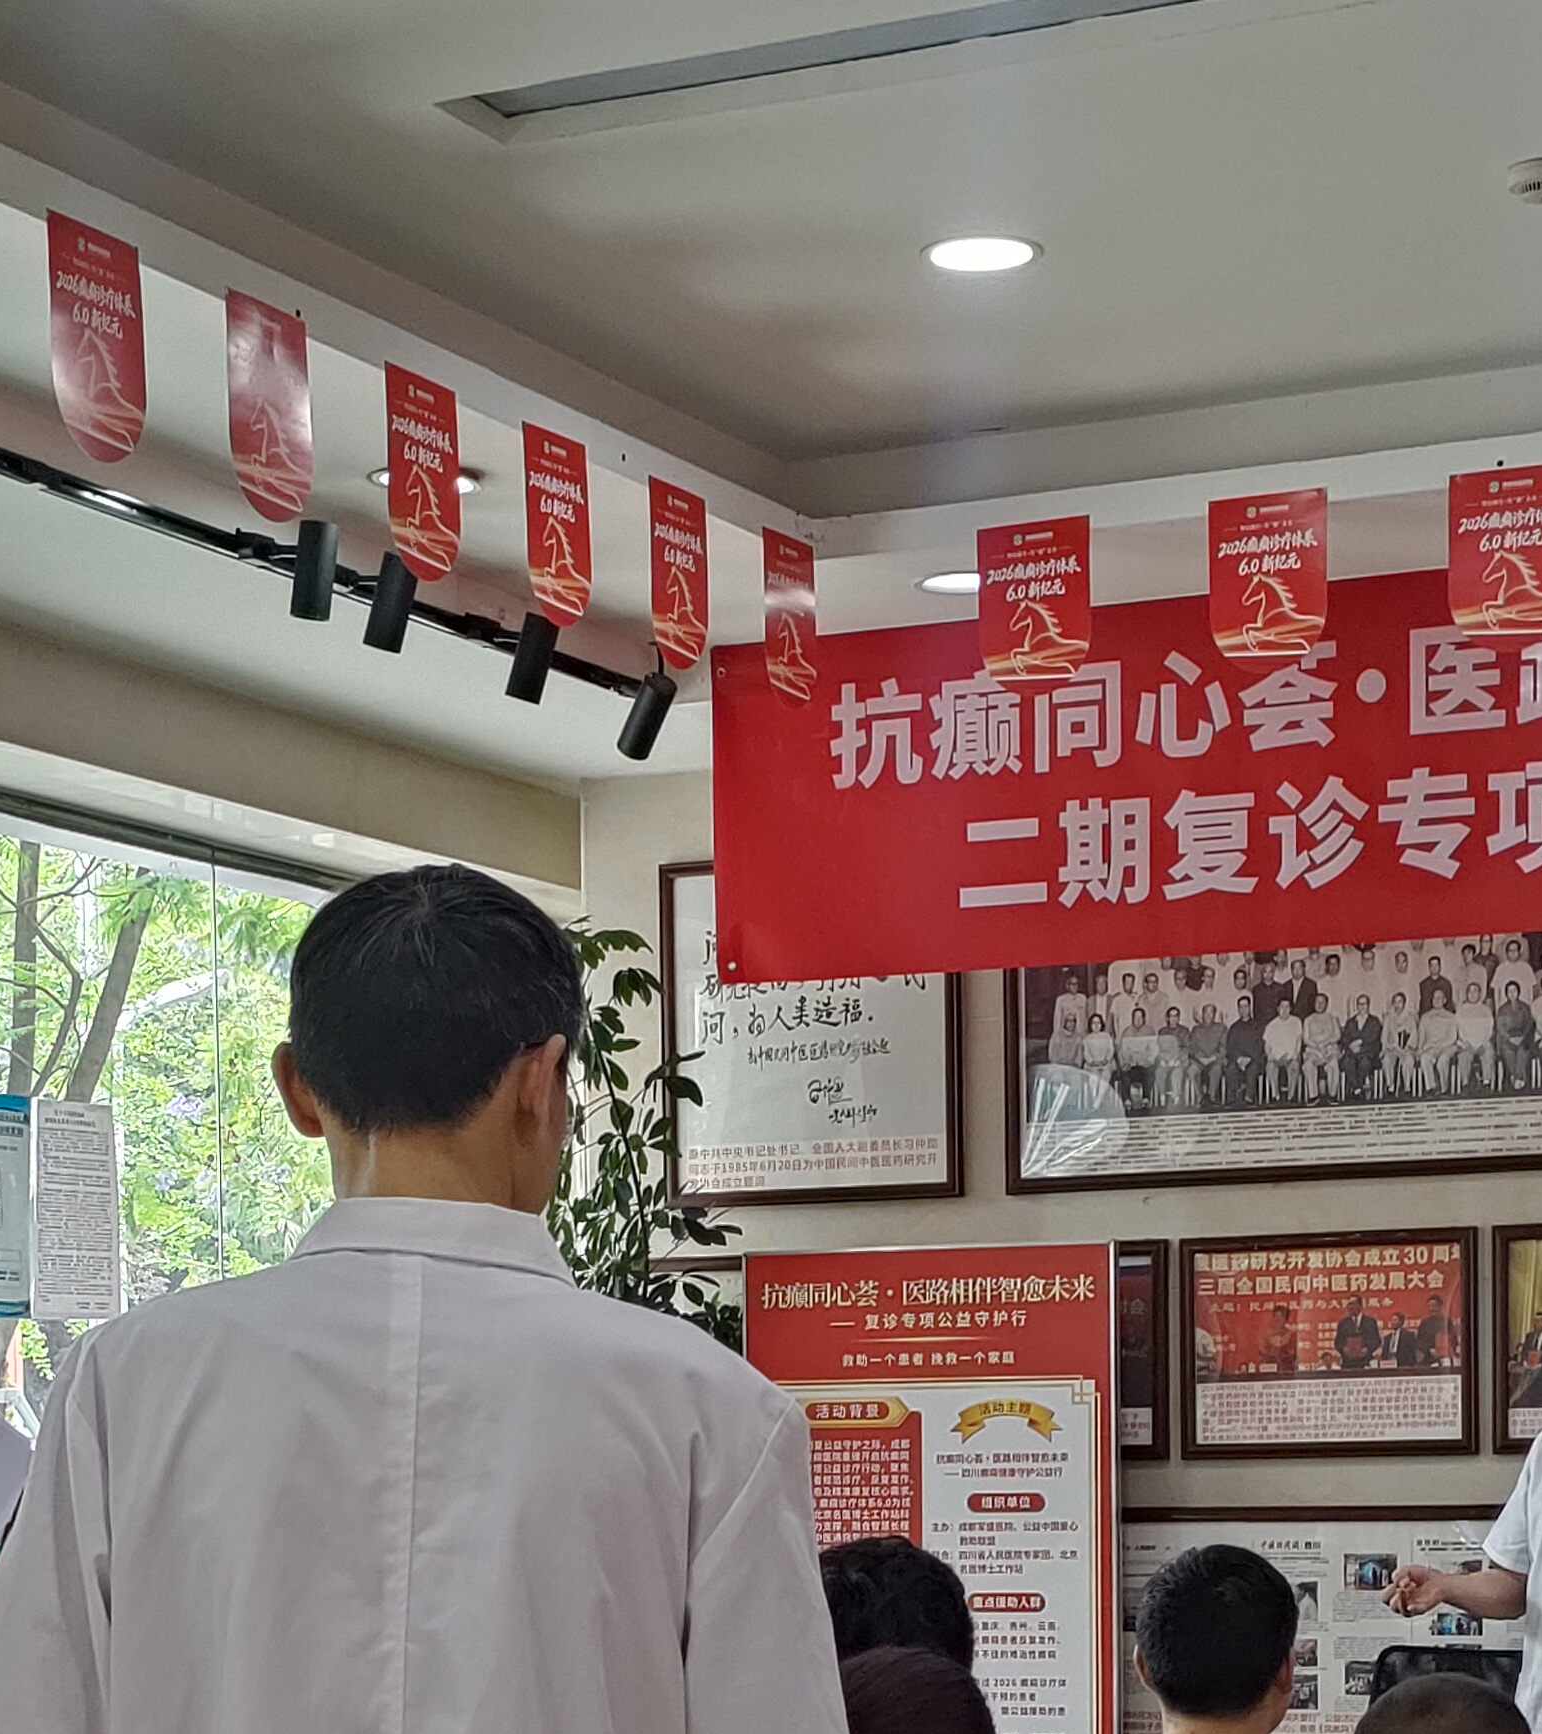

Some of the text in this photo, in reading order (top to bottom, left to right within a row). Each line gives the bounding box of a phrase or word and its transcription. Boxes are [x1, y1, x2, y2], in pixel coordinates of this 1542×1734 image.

[1479, 532, 1502, 553] 6.0
[1237, 555, 1261, 576] 6.0
[1006, 581, 1027, 601] 6.0
[761, 1273, 1096, 1310] 抗癫同心荟·医路相伴智愈未来
[864, 1310, 1028, 1331] 复诊专项公益守护行
[842, 1352, 924, 1367] 救助一个患者
[815, 1403, 880, 1419] 活动背景
[980, 1400, 1032, 1416] 活动主题
[981, 1496, 1032, 1509] 组织单位
[976, 1635, 1062, 1645] 癫痫患者反复发作、
[975, 1650, 1057, 1660] 不住的难治性癫痫
